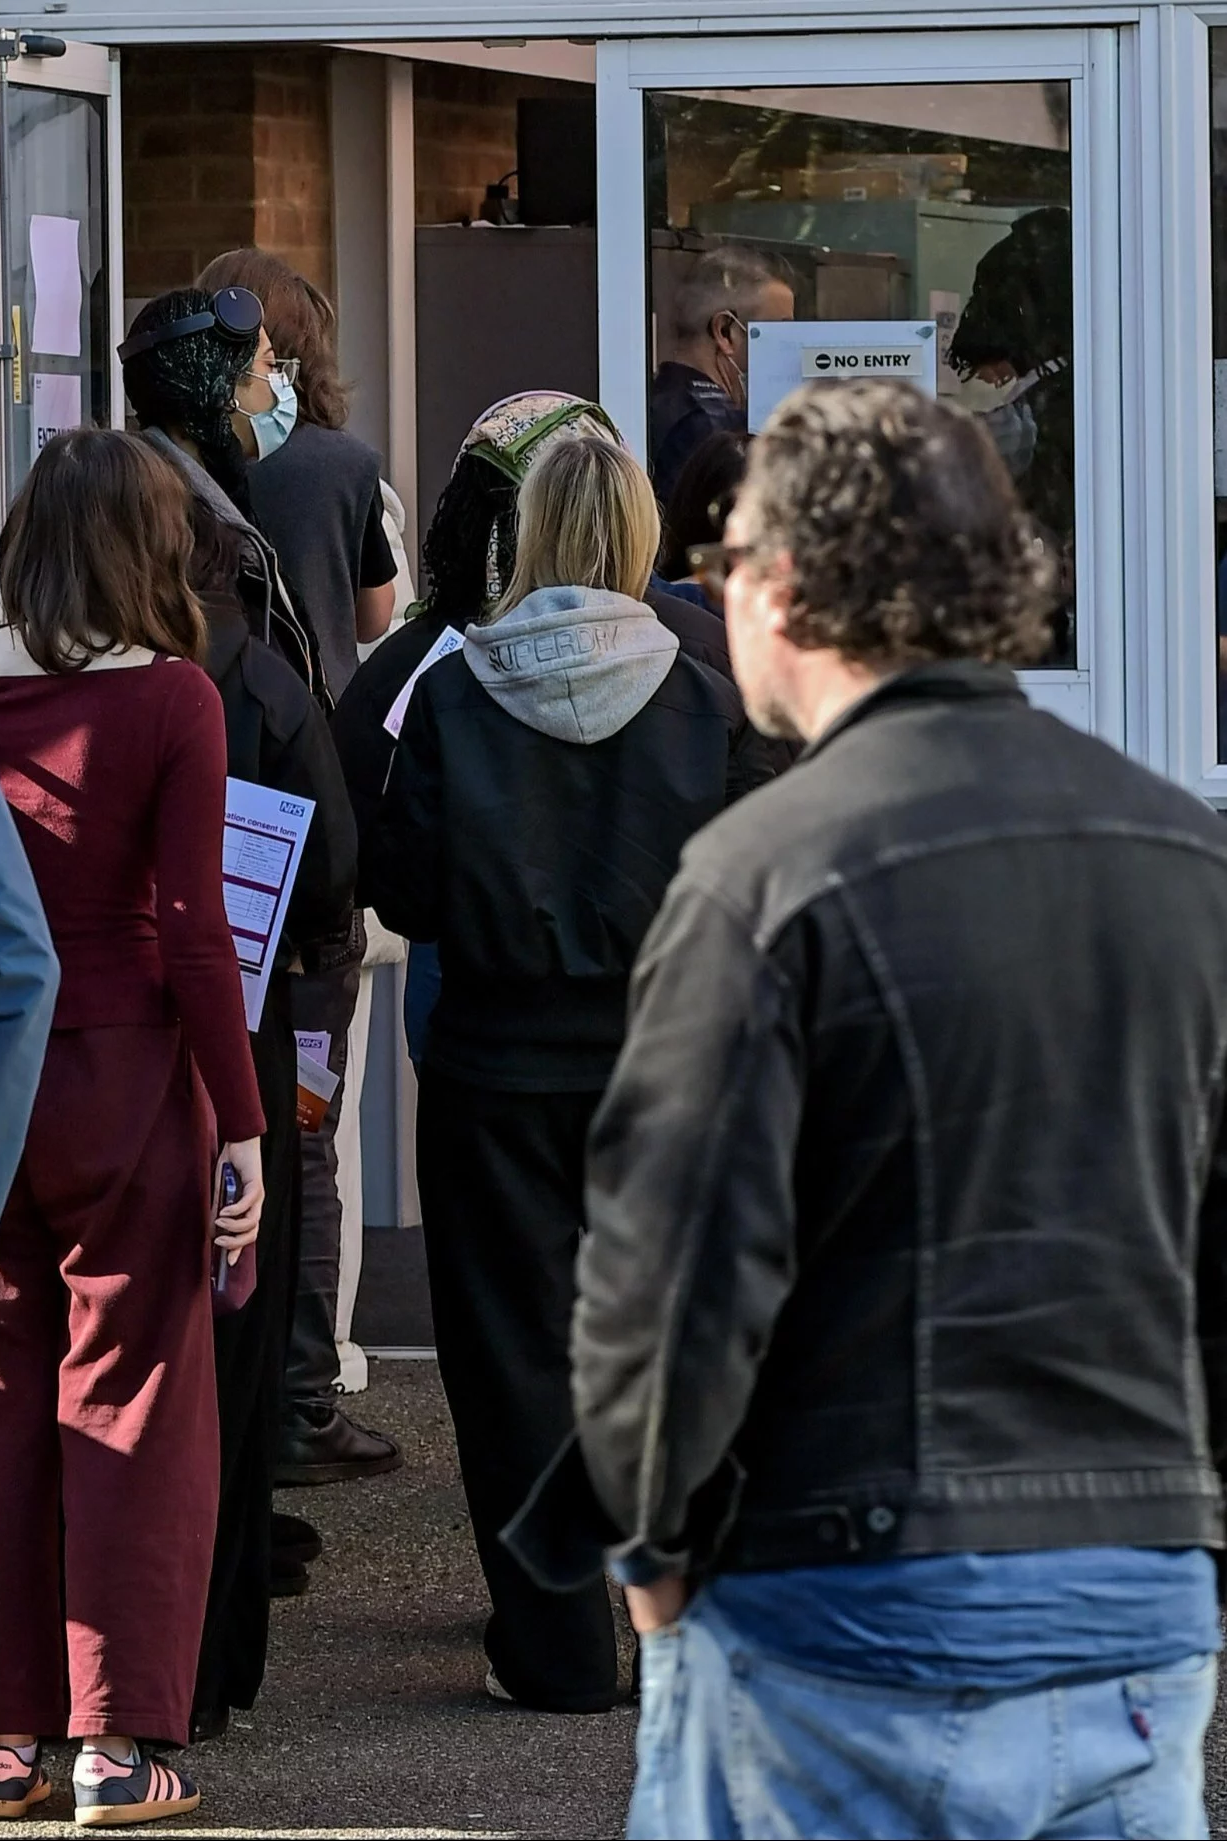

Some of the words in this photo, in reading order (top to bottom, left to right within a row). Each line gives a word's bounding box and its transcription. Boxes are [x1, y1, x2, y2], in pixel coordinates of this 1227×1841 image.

[834, 355, 859, 368] NO
[864, 354, 911, 368] ENTRY
[280, 801, 305, 817] NHS
[247, 818, 279, 833] consent
[279, 826, 297, 838] form
[299, 1038, 322, 1049] NHS
